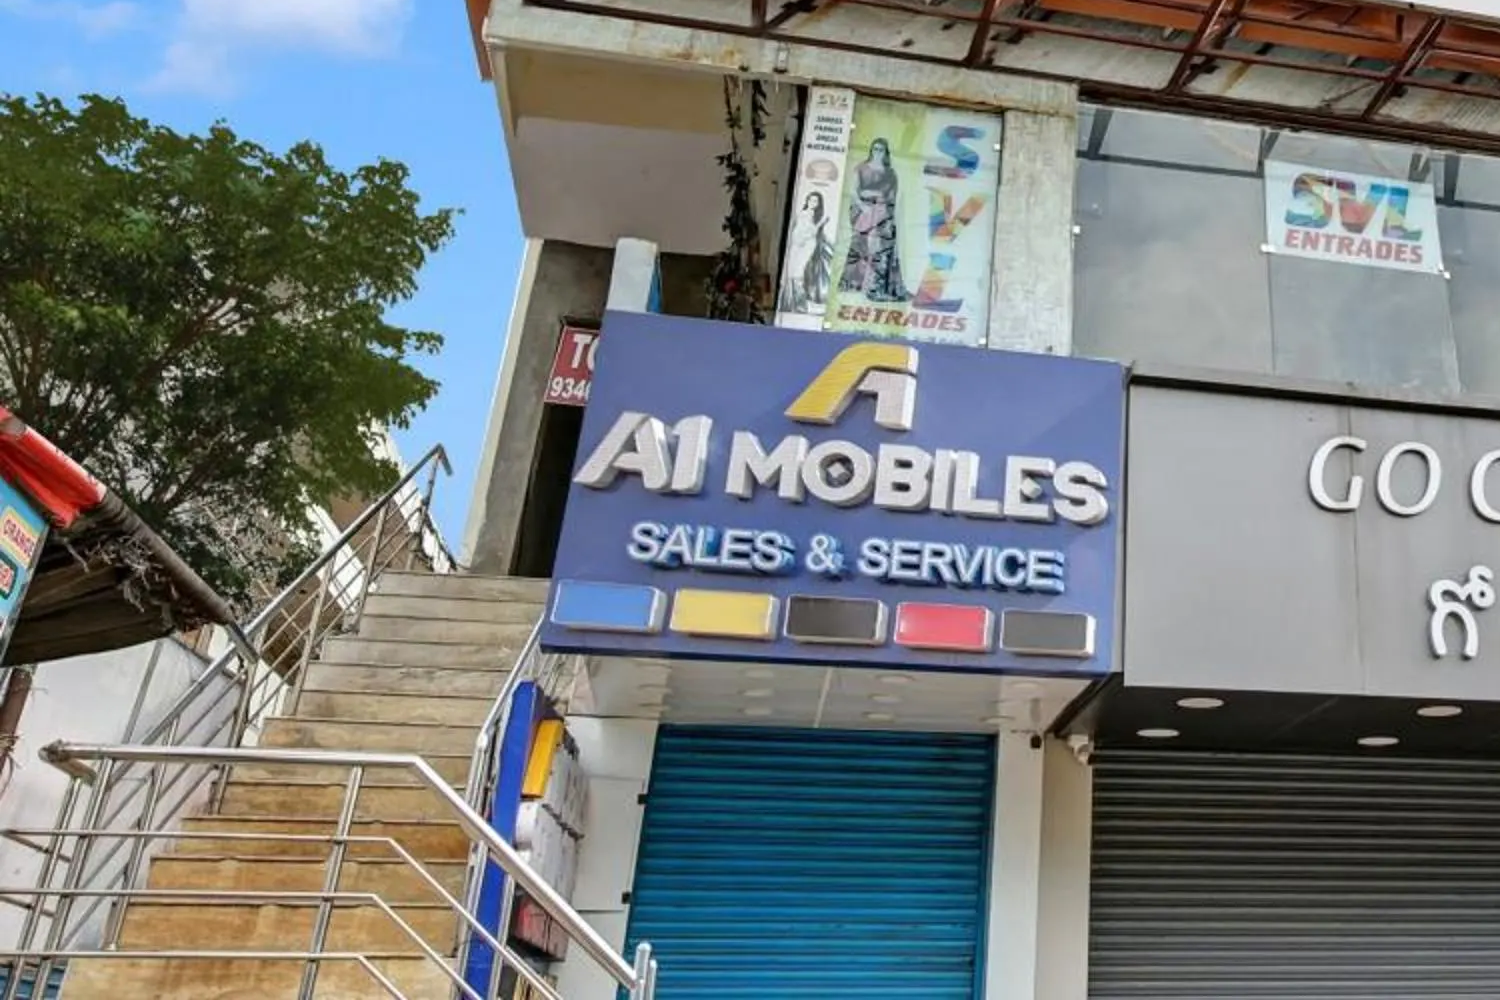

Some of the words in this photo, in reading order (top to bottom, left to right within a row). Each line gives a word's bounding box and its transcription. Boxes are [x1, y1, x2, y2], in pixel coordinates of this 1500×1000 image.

[1284, 172, 1423, 241] SVL
[1284, 229, 1423, 264] ENTRADES
[837, 304, 968, 333] ENTRADES
[573, 411, 713, 495] A1
[725, 431, 1109, 525] MOBILES
[1308, 435, 1442, 517] GO
[627, 521, 795, 576] SALES
[805, 534, 844, 579] &
[858, 536, 1066, 595] SERVICE
[1428, 564, 1497, 659] గో
